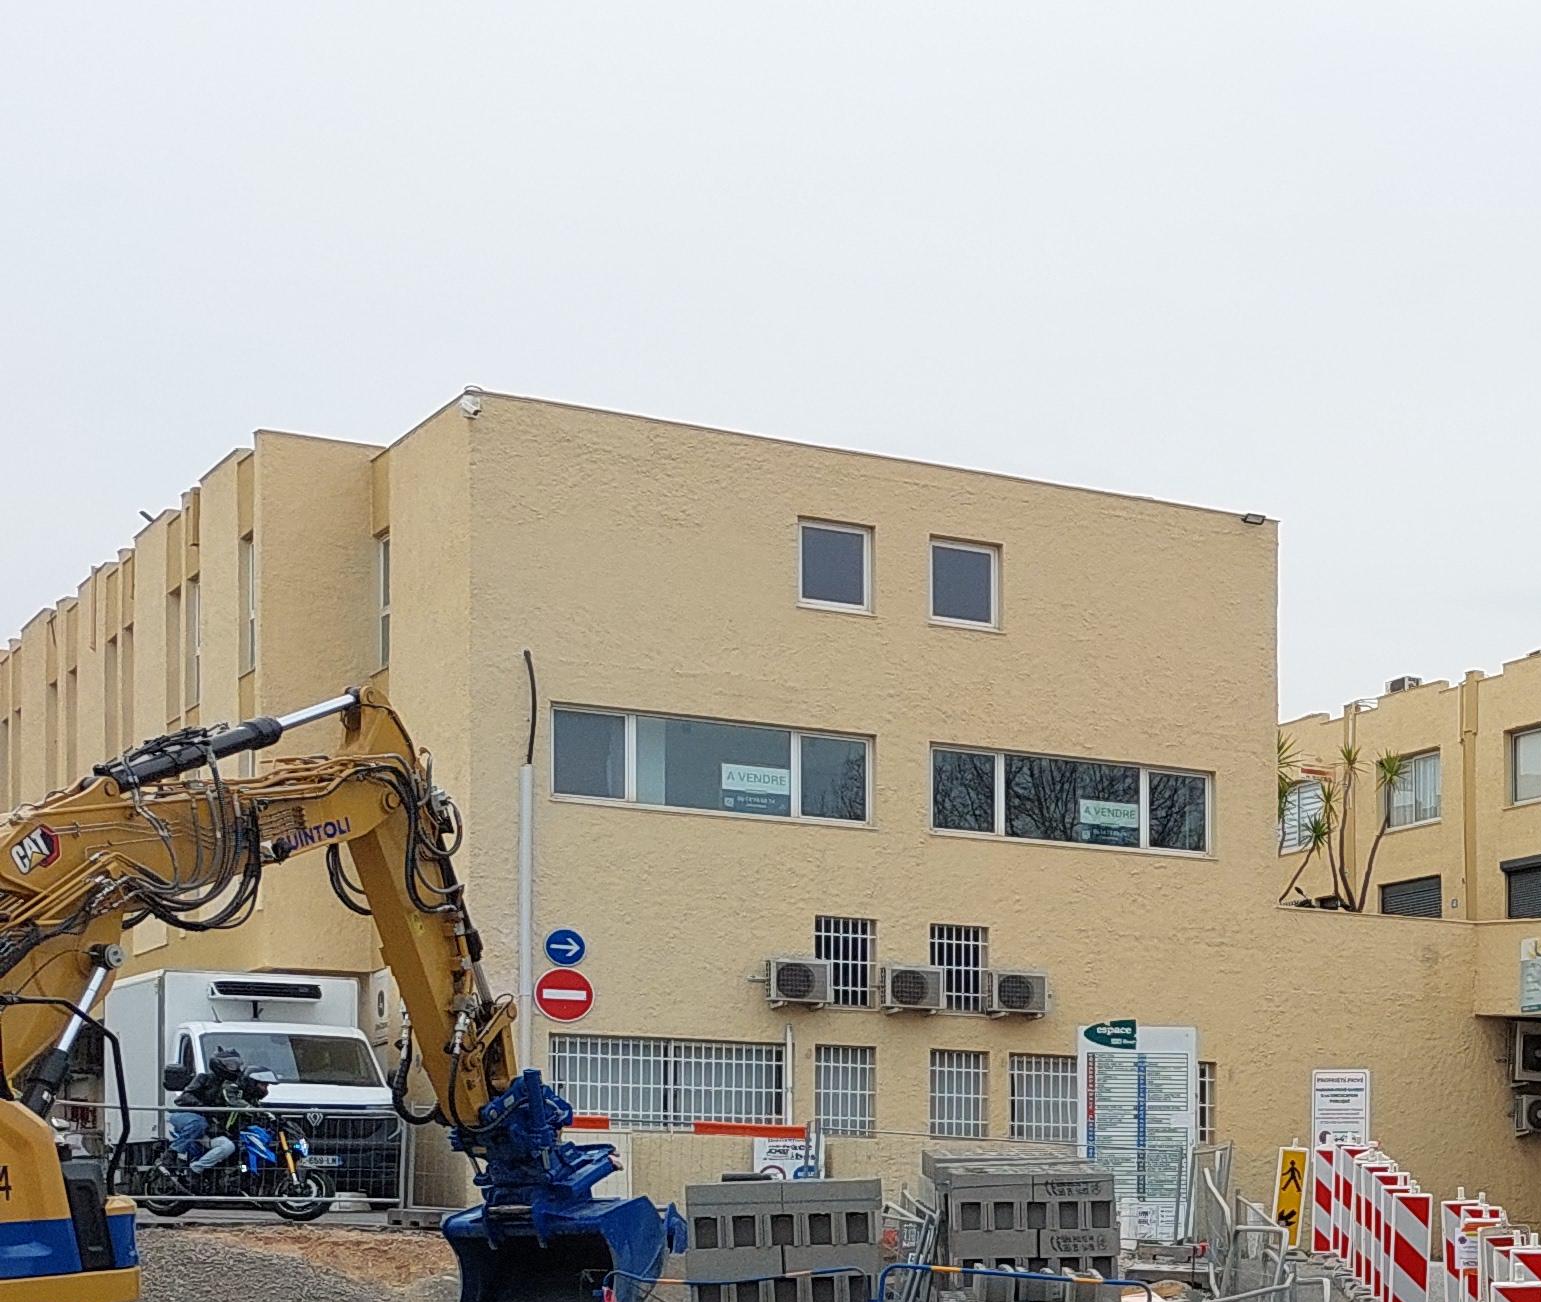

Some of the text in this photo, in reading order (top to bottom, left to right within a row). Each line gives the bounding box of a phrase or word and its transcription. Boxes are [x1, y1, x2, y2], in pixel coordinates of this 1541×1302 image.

[738, 772, 787, 785] VENDRE
[1095, 807, 1136, 819] VENDRE
[284, 816, 351, 850] UINTOLI
[11, 827, 50, 875] CAT
